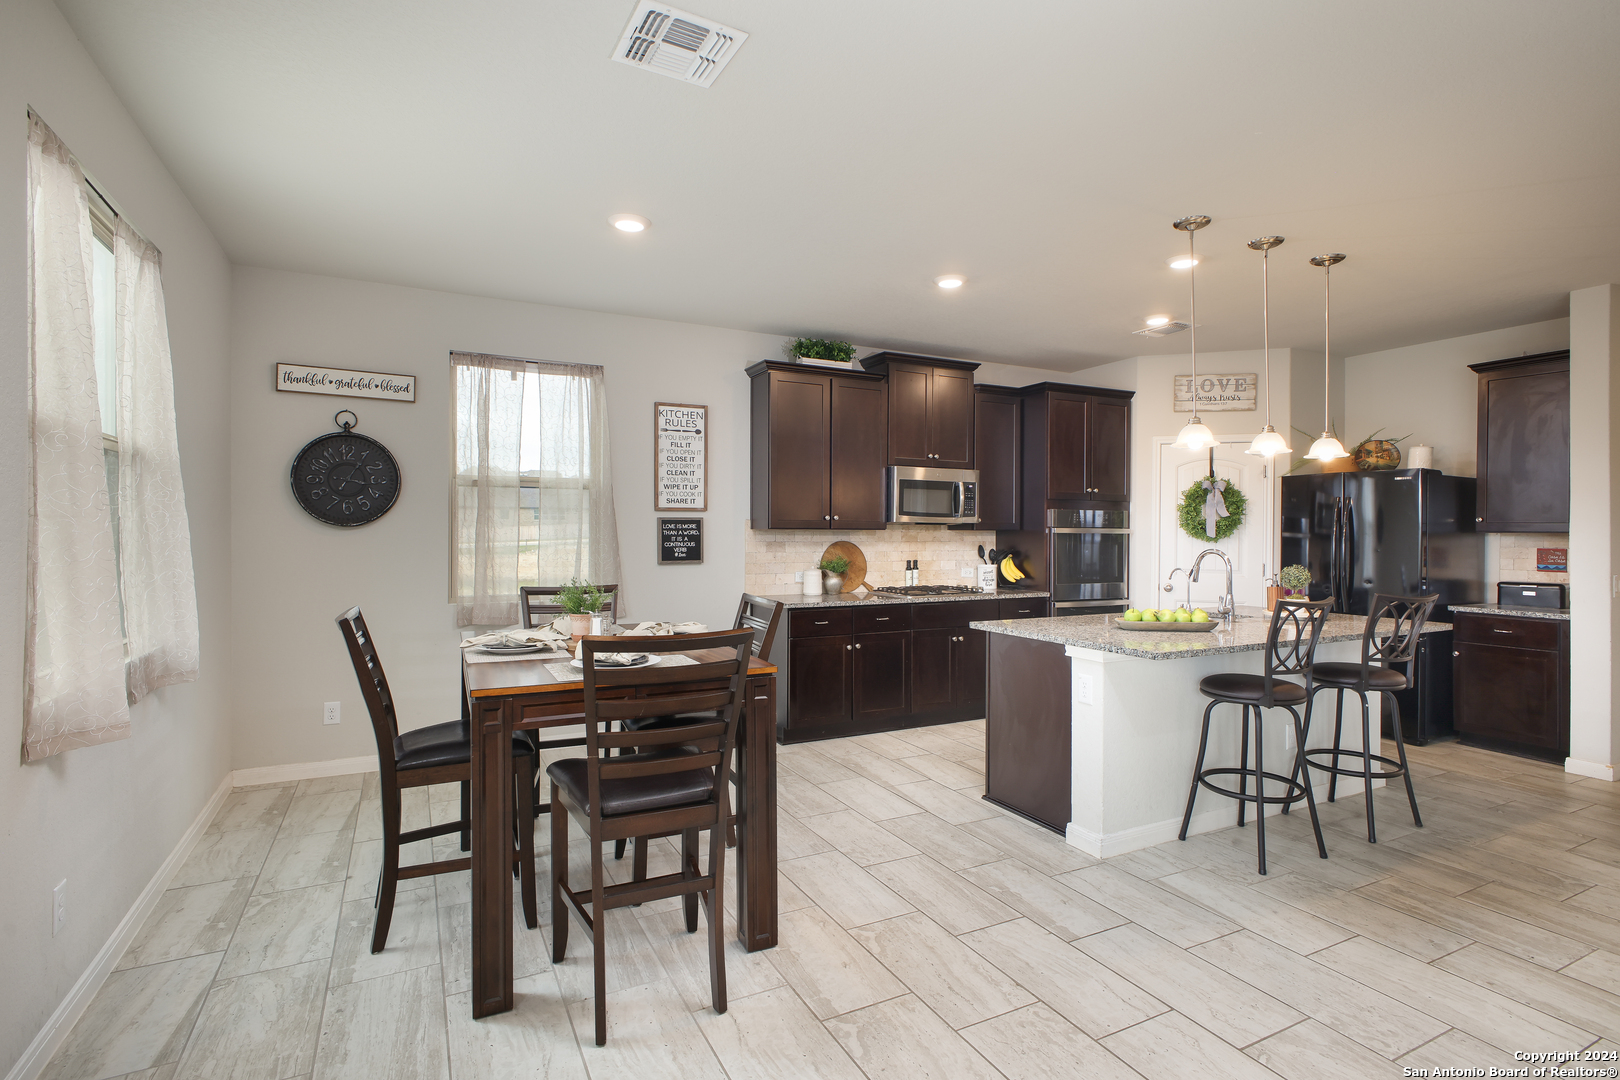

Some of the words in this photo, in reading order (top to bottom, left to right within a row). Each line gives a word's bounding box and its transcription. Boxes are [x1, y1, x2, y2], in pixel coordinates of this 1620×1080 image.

[283, 371, 329, 386] thankful
[335, 377, 374, 390] grateful
[380, 378, 410, 393] blessed
[1185, 378, 1247, 393] LOVE
[659, 410, 703, 419] KITCHEN
[665, 419, 697, 428] RULES
[323, 448, 338, 463] 11
[339, 445, 355, 460] 12
[310, 459, 328, 472] 10
[366, 461, 383, 474] 2
[307, 475, 324, 484] 9
[371, 475, 387, 485] 3
[311, 487, 328, 500] 8
[368, 487, 384, 499] 4
[326, 496, 339, 510] 7
[342, 500, 354, 514] 6
[357, 496, 371, 511] 5
